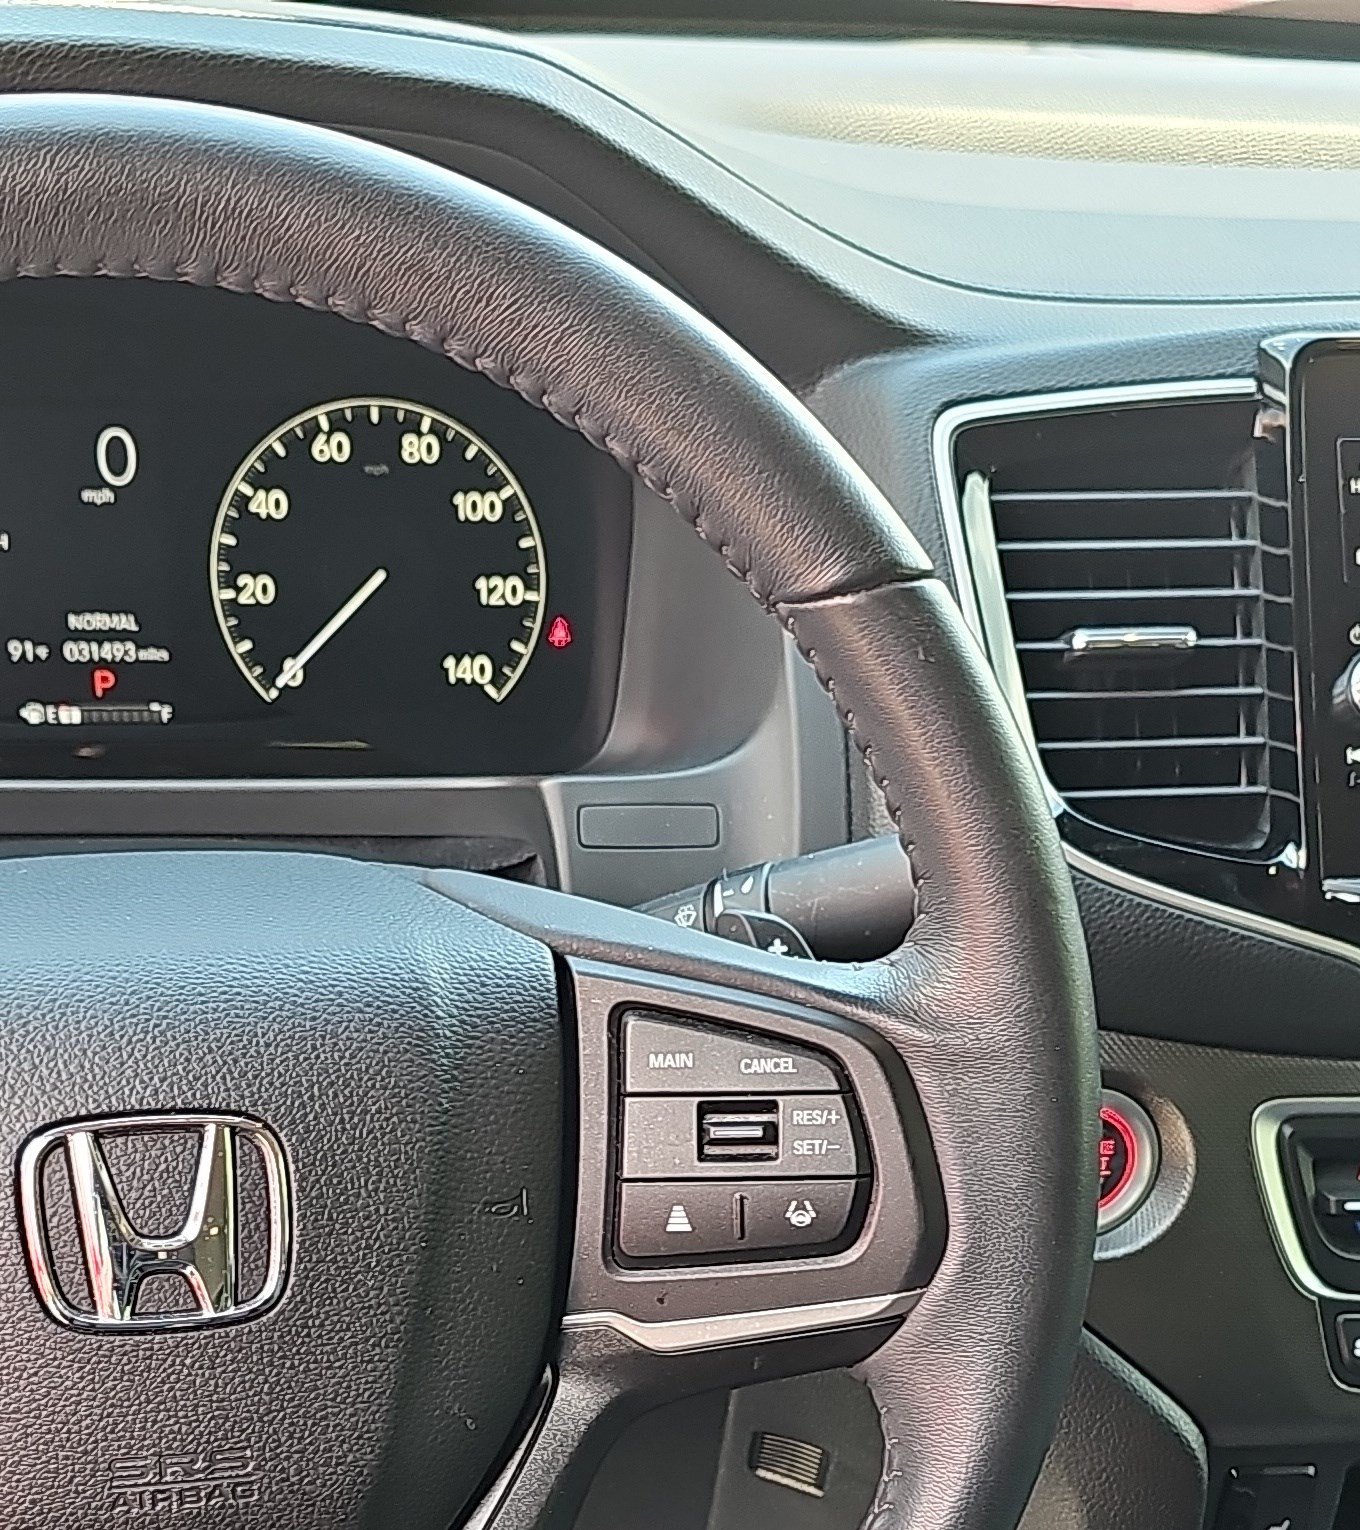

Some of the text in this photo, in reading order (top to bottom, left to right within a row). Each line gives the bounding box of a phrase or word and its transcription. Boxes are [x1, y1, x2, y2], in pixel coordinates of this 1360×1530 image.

[96, 426, 138, 488] 0
[311, 432, 352, 463] 60
[401, 432, 441, 464] 80
[80, 488, 115, 505] mph
[248, 489, 290, 520] 40
[452, 491, 503, 523] 100
[236, 574, 277, 605] 20
[475, 576, 525, 606] 120
[67, 612, 140, 632] NORMAL
[62, 640, 137, 663] 031493
[93, 669, 116, 698] P
[443, 654, 493, 685] 140
[45, 704, 58, 725] E
[648, 1052, 694, 1069] MAIN
[740, 1057, 798, 1074] CANCEL
[792, 1110, 841, 1125] RES/+
[108, 1447, 256, 1482] SRS
